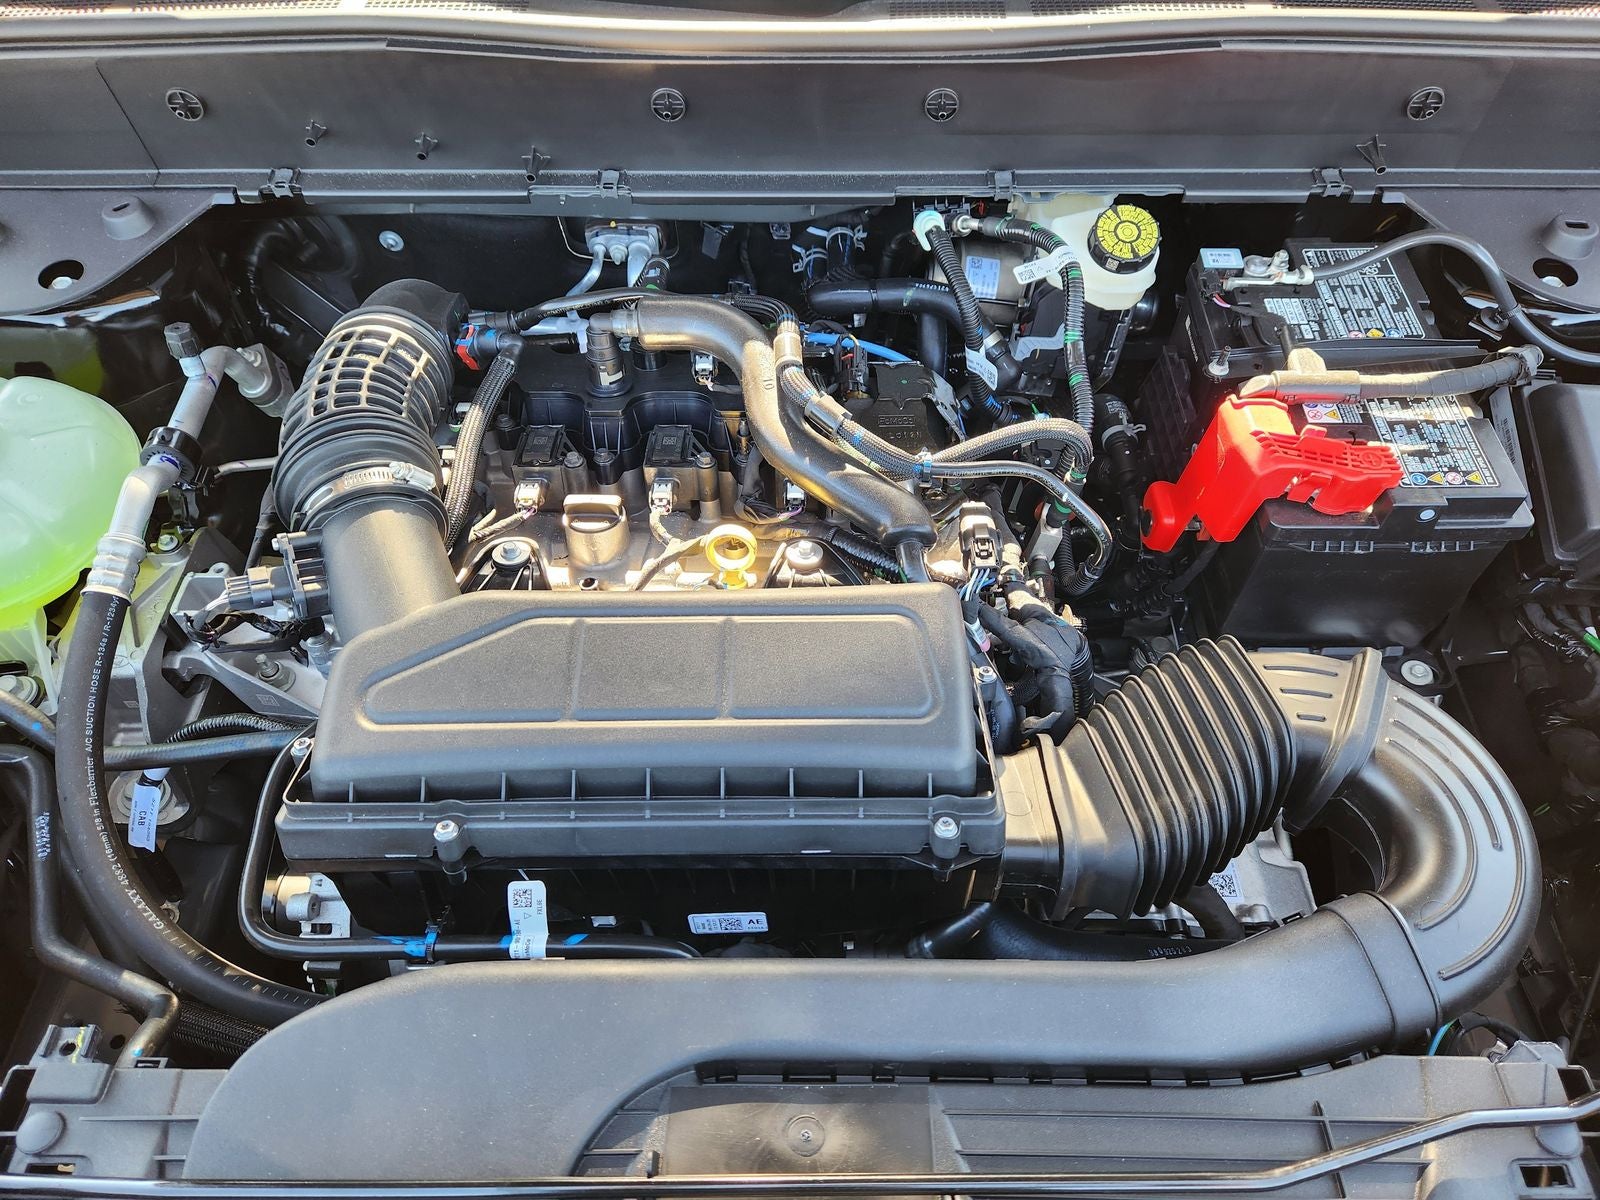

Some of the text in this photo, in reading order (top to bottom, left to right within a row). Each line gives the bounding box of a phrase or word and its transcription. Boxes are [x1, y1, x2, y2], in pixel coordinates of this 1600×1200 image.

[94, 637, 108, 667] R-134a
[90, 668, 101, 693] HOSE
[85, 695, 96, 737] SUCTION
[85, 737, 93, 752] A/C
[85, 757, 99, 806] Flexbarrier
[93, 808, 100, 817] in
[94, 817, 105, 831] 5/8
[138, 810, 147, 826] CAB
[99, 831, 118, 861] (16mm)
[111, 863, 129, 886] 4882
[125, 888, 164, 930] GALAXY
